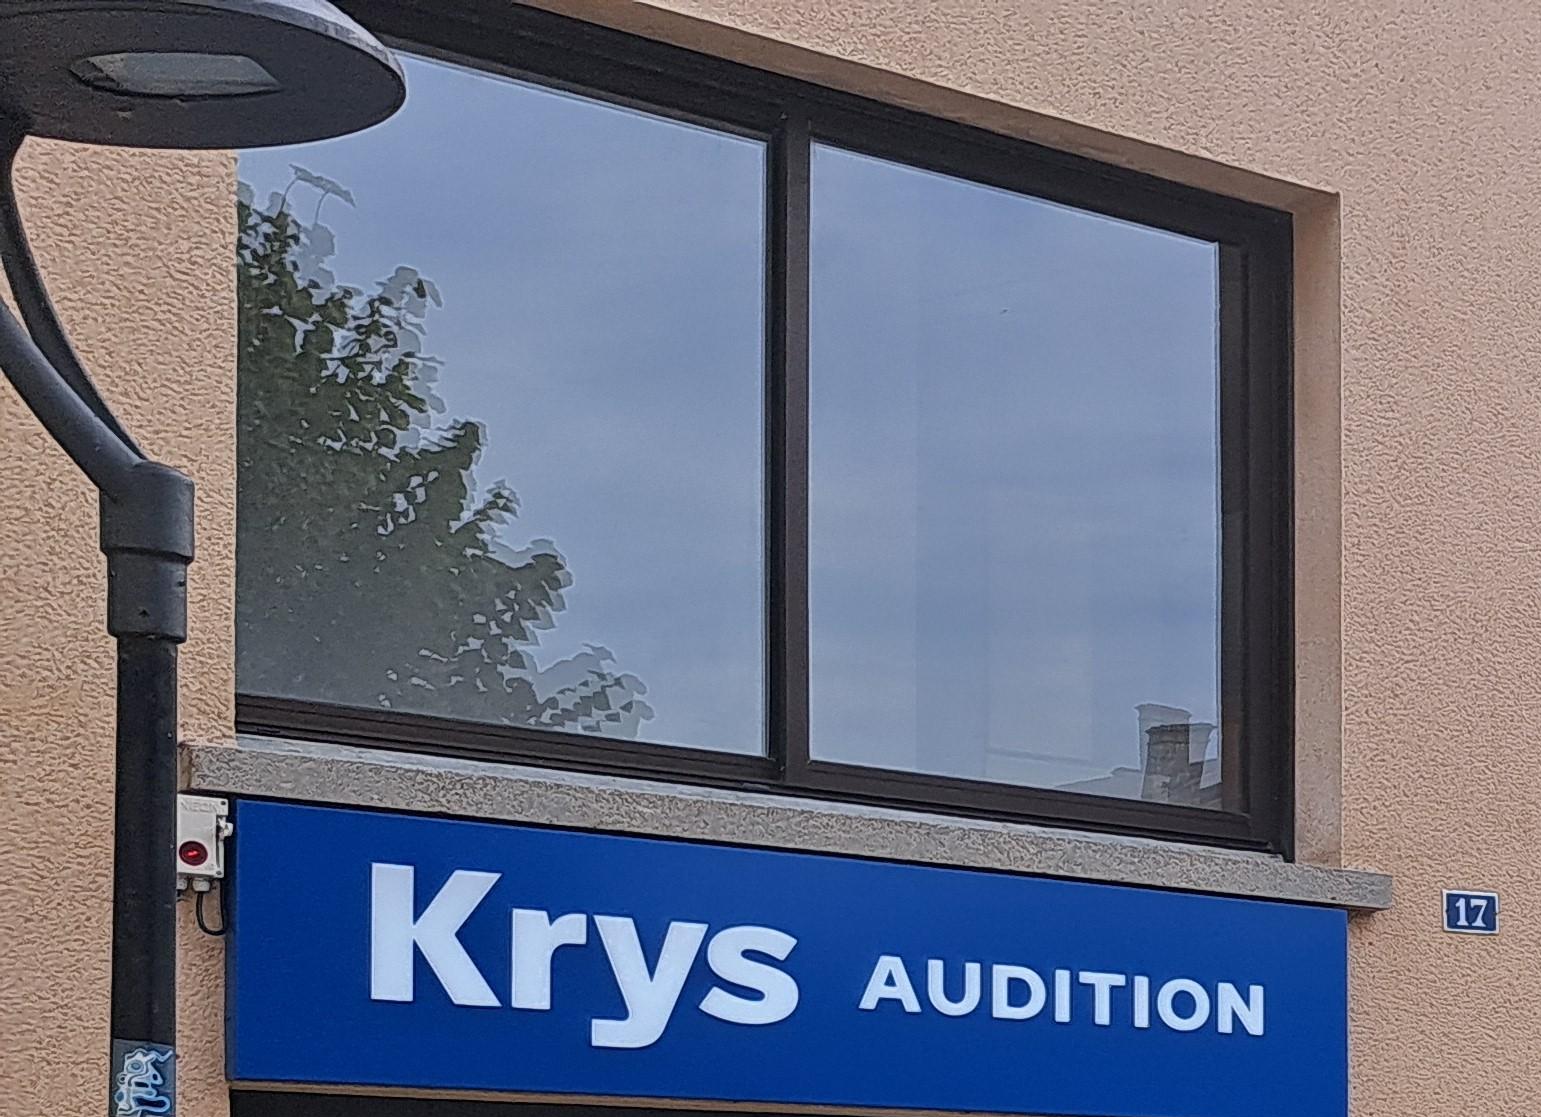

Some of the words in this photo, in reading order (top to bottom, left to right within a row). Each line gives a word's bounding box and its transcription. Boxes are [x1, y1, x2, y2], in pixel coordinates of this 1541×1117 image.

[370, 862, 799, 1048] Krys
[859, 955, 1264, 1036] AUDITION
[1455, 897, 1488, 928] 17
